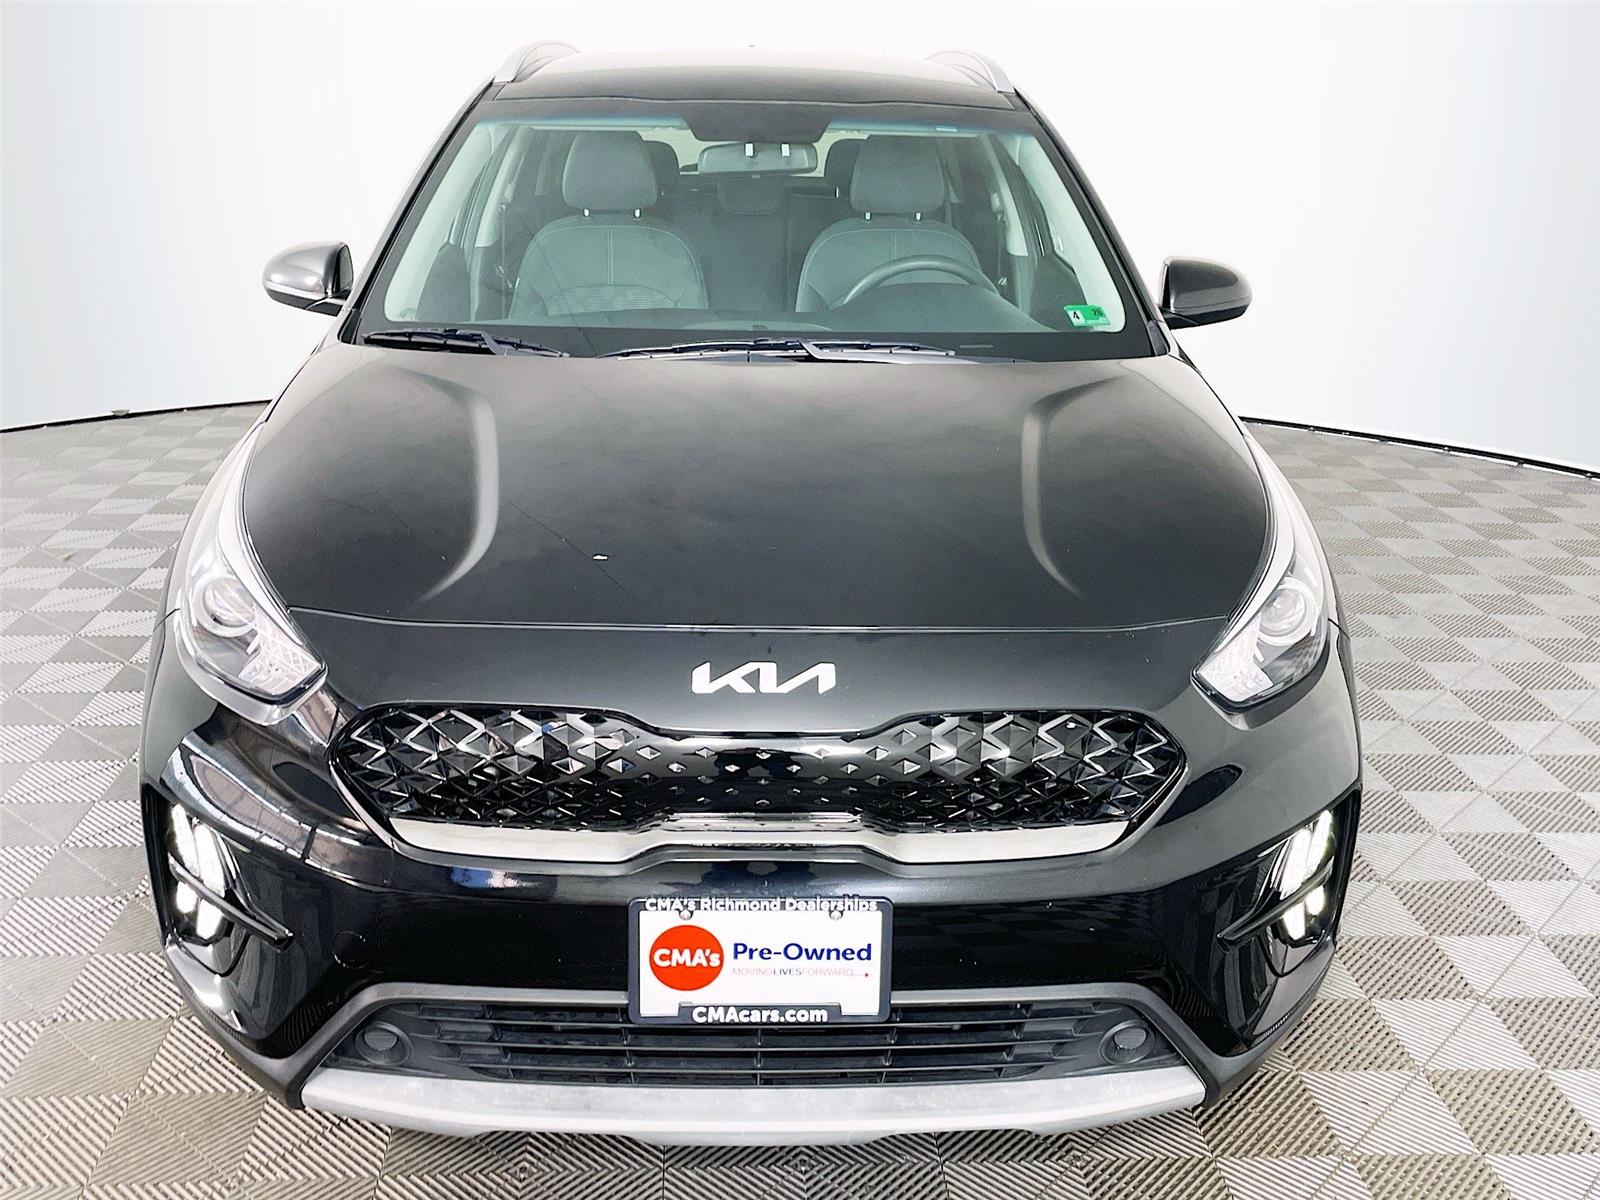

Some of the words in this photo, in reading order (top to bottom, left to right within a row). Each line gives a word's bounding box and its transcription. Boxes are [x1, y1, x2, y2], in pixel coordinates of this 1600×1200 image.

[645, 899, 695, 911] CMA's
[701, 899, 780, 911] Richmond
[785, 898, 877, 913] Dealerships
[653, 948, 721, 968] CMA's
[733, 943, 872, 961] Pre-Owned
[692, 1006, 828, 1023] CMAcars.com
